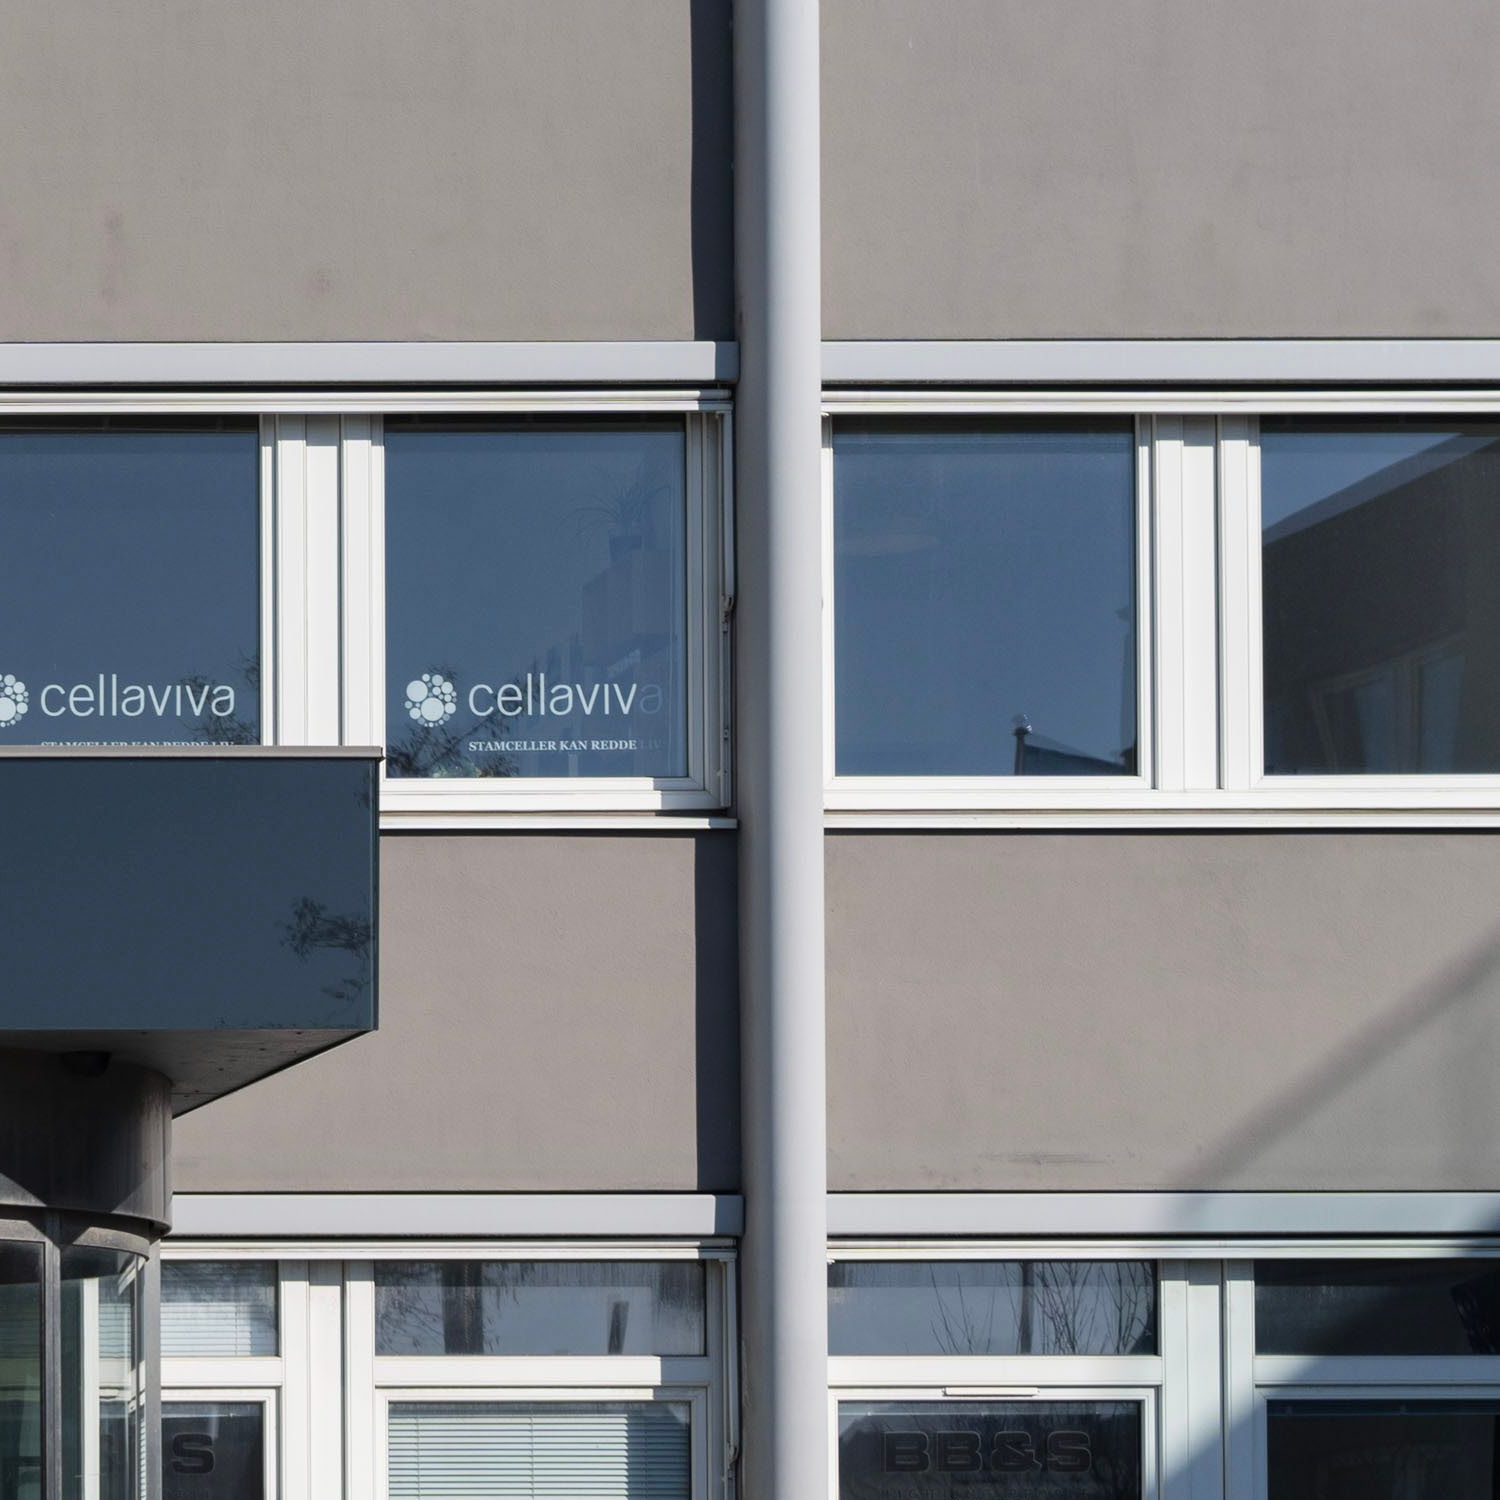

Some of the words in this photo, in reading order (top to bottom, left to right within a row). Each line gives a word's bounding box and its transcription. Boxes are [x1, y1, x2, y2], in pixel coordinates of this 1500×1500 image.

[40, 673, 236, 717] cellaviva
[468, 741, 557, 751] STAMCELLER
[560, 741, 589, 751] KAN
[591, 740, 637, 750] REDDE
[883, 1430, 1093, 1474] BB&S
